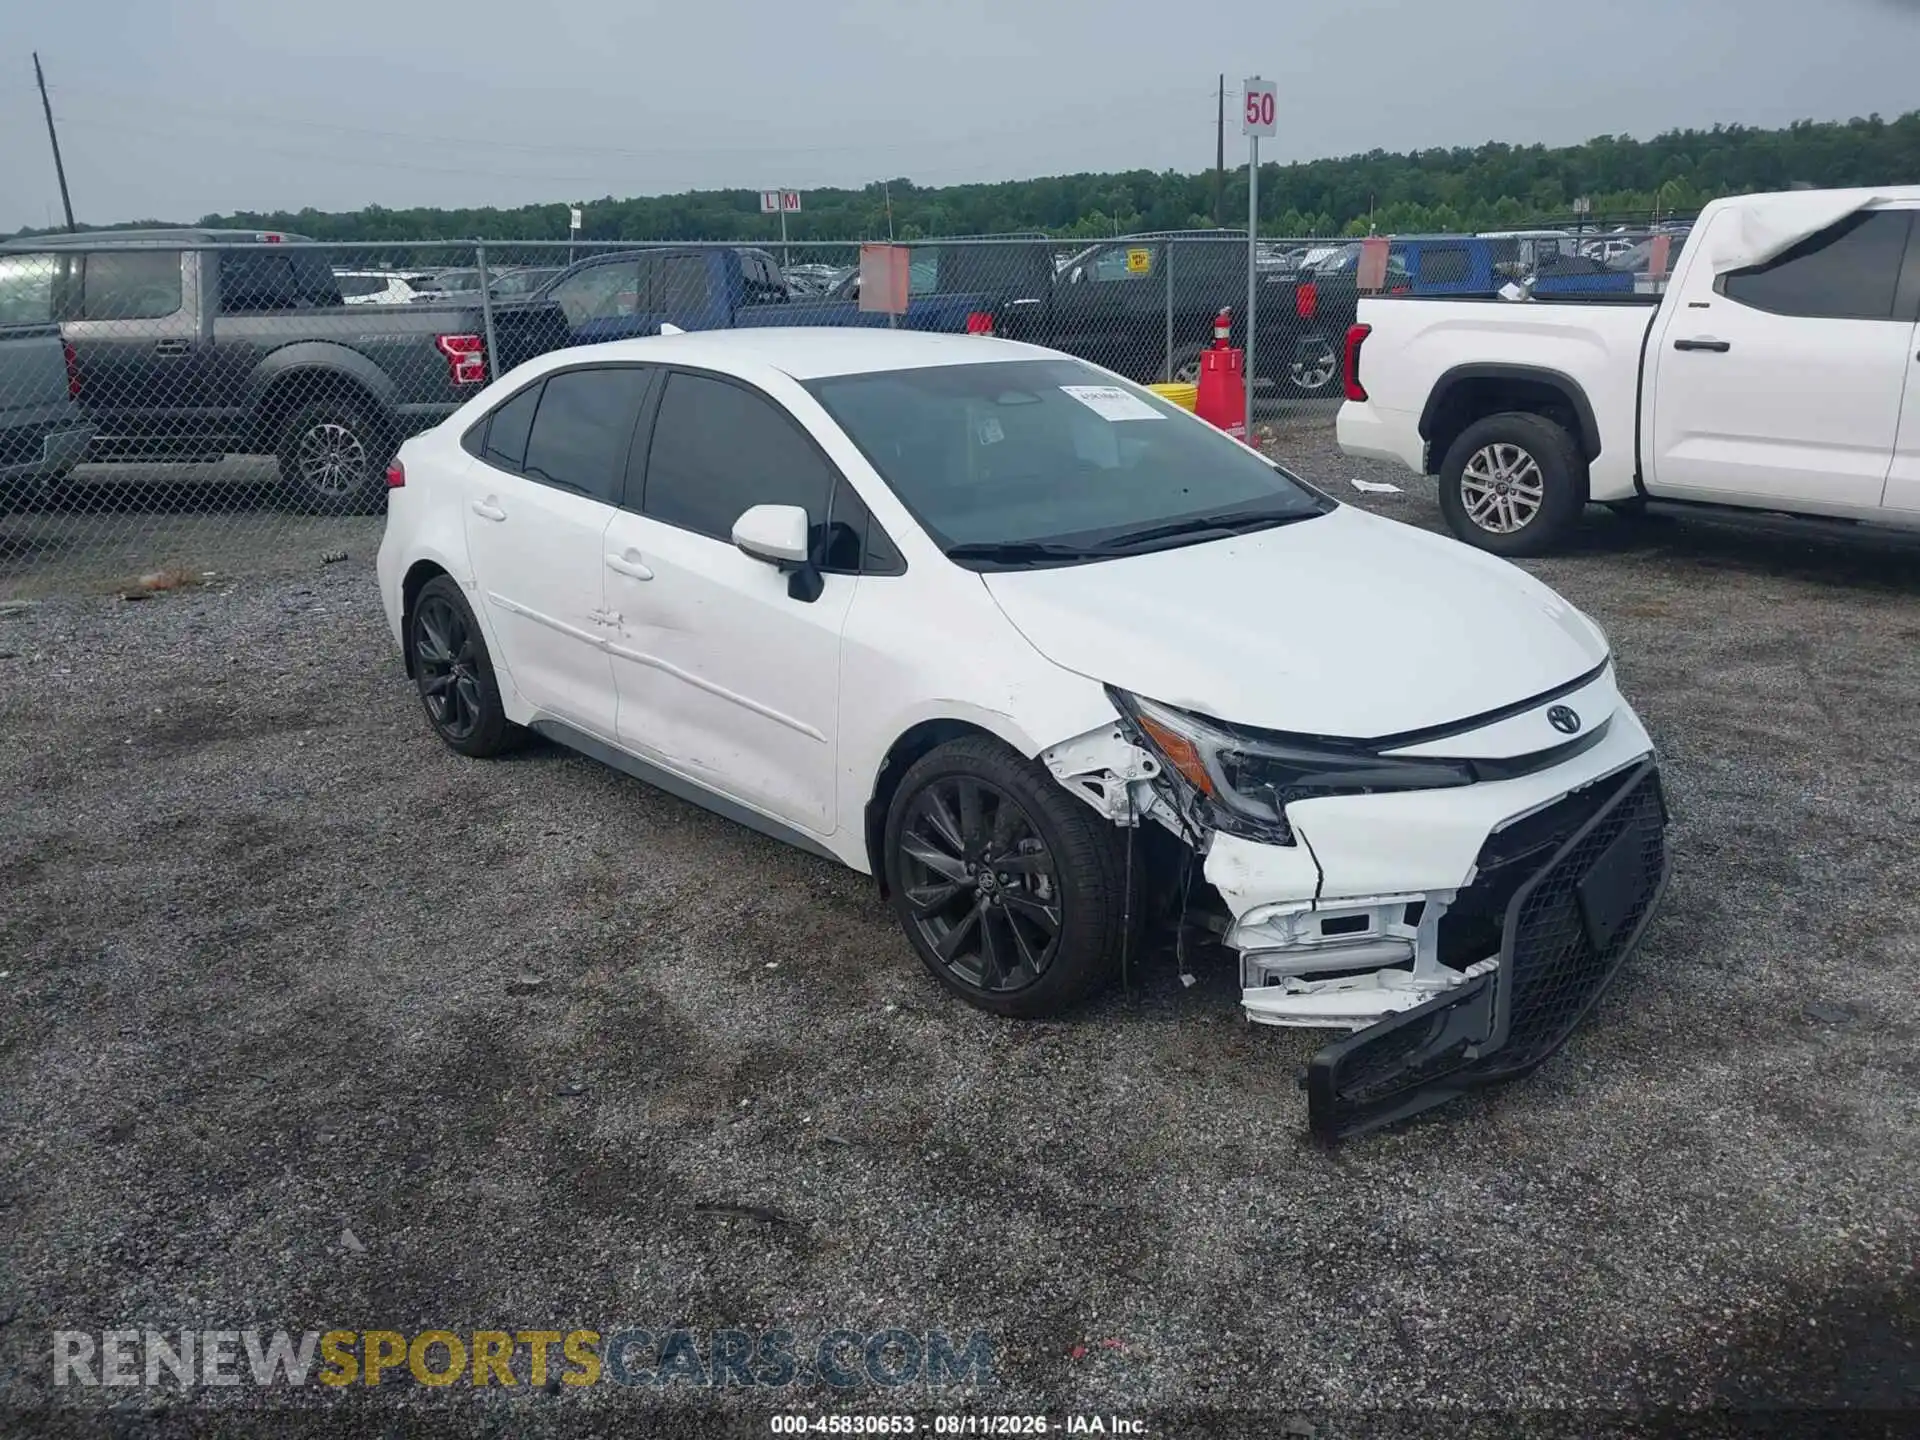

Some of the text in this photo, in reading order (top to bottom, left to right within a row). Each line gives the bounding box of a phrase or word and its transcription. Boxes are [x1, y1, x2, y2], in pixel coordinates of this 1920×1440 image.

[1247, 92, 1275, 125] 50
[765, 192, 799, 209] L M
